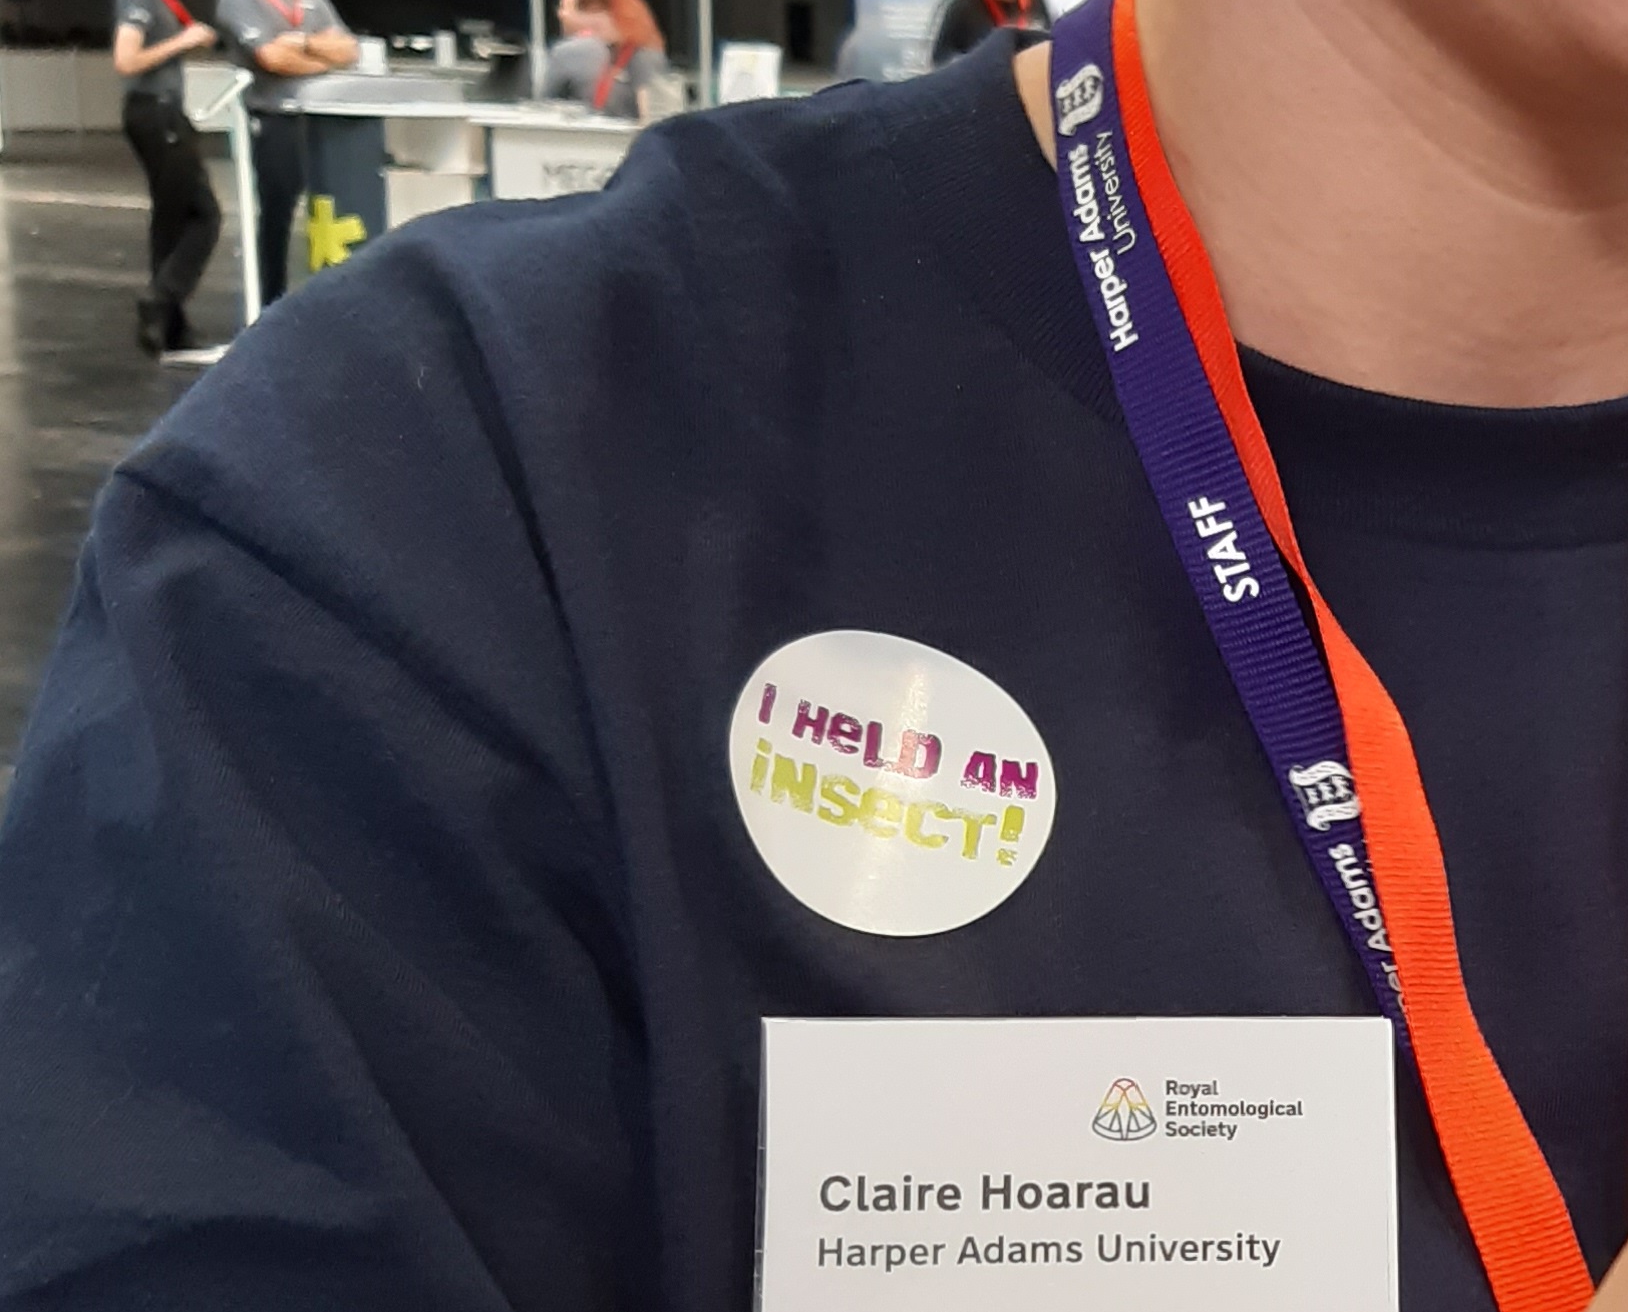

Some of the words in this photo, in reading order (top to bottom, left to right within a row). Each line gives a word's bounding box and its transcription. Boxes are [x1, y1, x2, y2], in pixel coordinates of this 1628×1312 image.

[1068, 143, 1105, 242] Adams
[1093, 129, 1137, 255] University
[1089, 248, 1139, 352] Harper
[1187, 496, 1260, 603] STAFF
[758, 683, 777, 724] I
[960, 750, 1039, 800] AN
[1328, 843, 1394, 953] Adams
[1165, 1079, 1219, 1099] Royal
[1165, 1100, 1304, 1120] Entomological
[1165, 1121, 1238, 1140] Society
[819, 1174, 962, 1212] Claire
[981, 1173, 1151, 1210] Hoarau
[818, 1237, 946, 1273] Harper
[957, 1235, 1083, 1265] Adams
[1097, 1232, 1281, 1268] University
